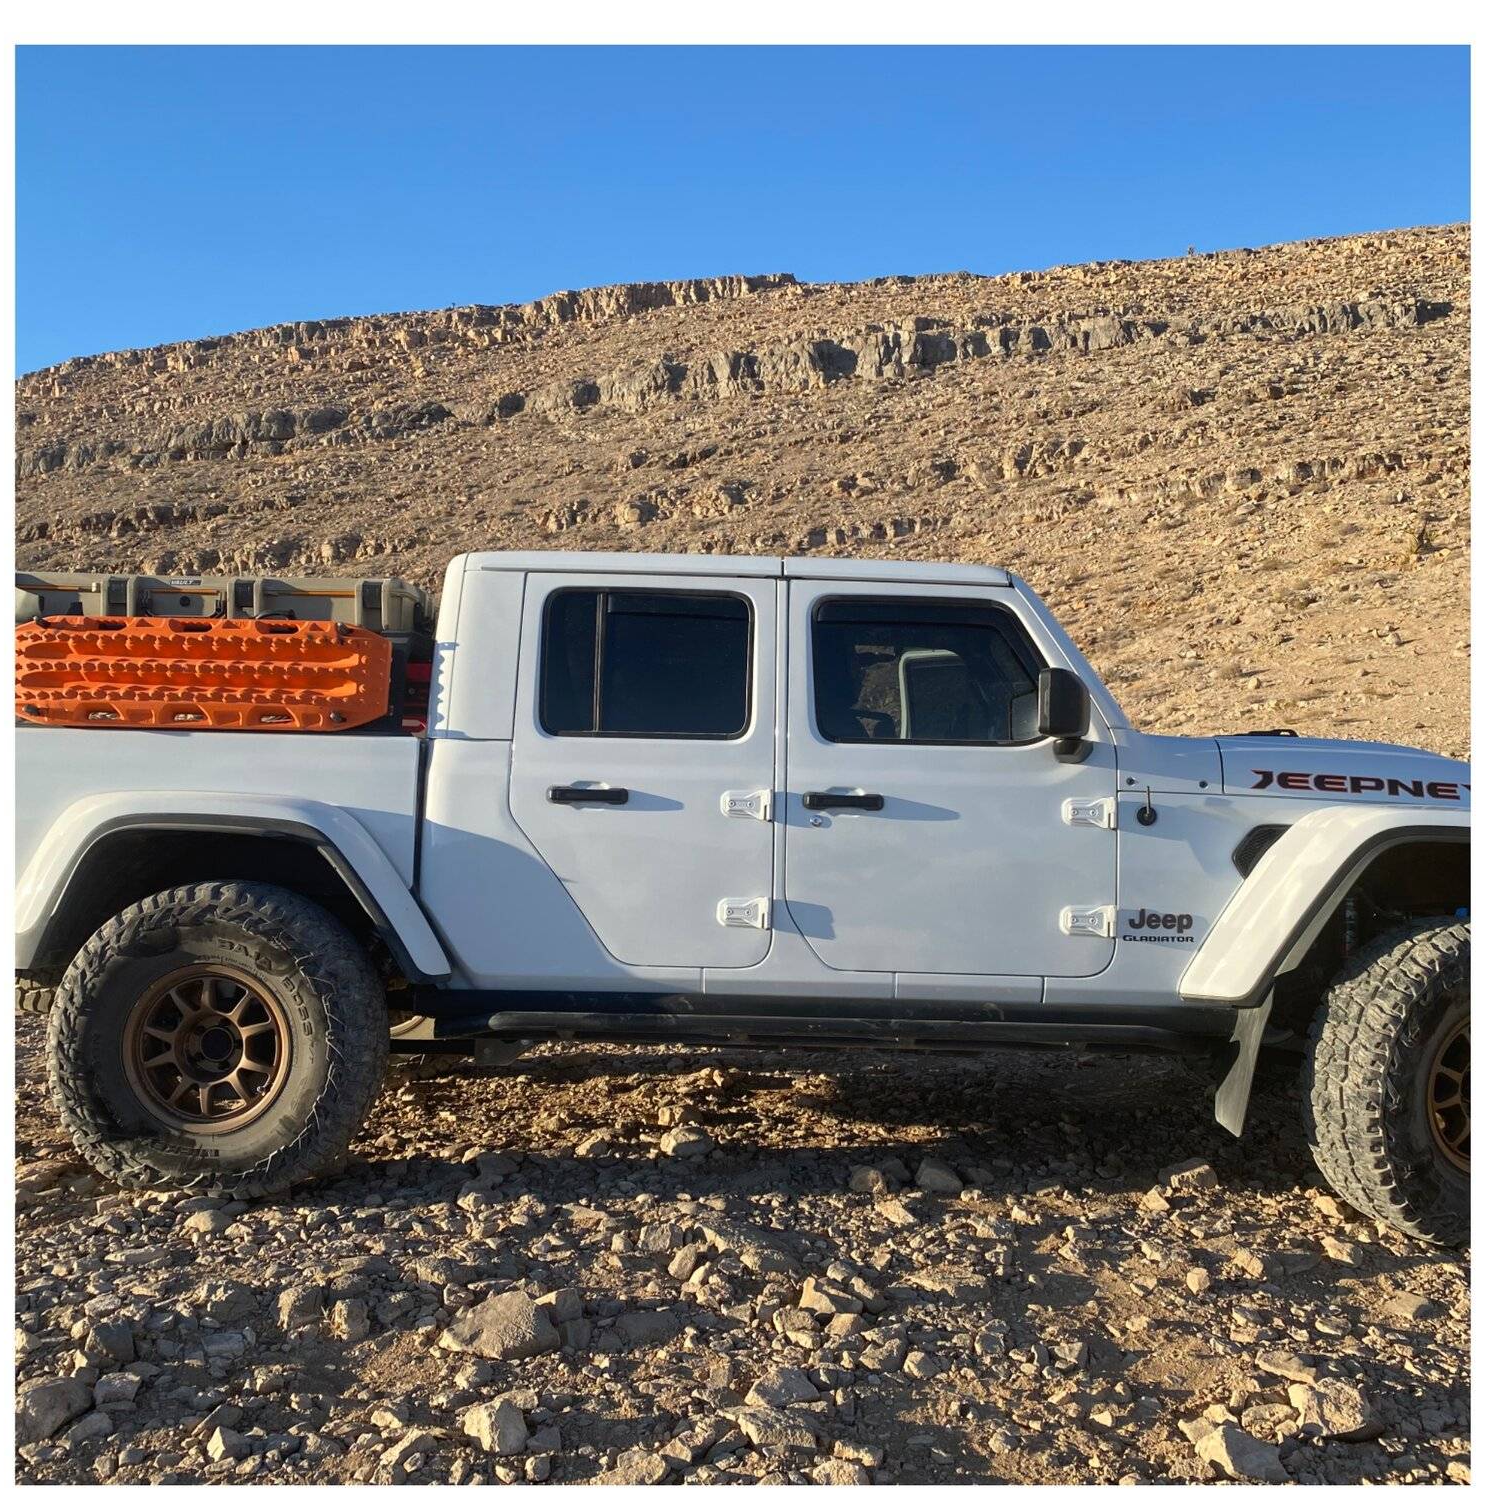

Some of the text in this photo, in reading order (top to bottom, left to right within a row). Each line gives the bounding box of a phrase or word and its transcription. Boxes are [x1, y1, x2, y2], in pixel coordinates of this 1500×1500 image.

[1250, 769, 1470, 800] JEEPNE
[1128, 908, 1193, 934] Jeep
[1122, 934, 1195, 943] GLADIATOR
